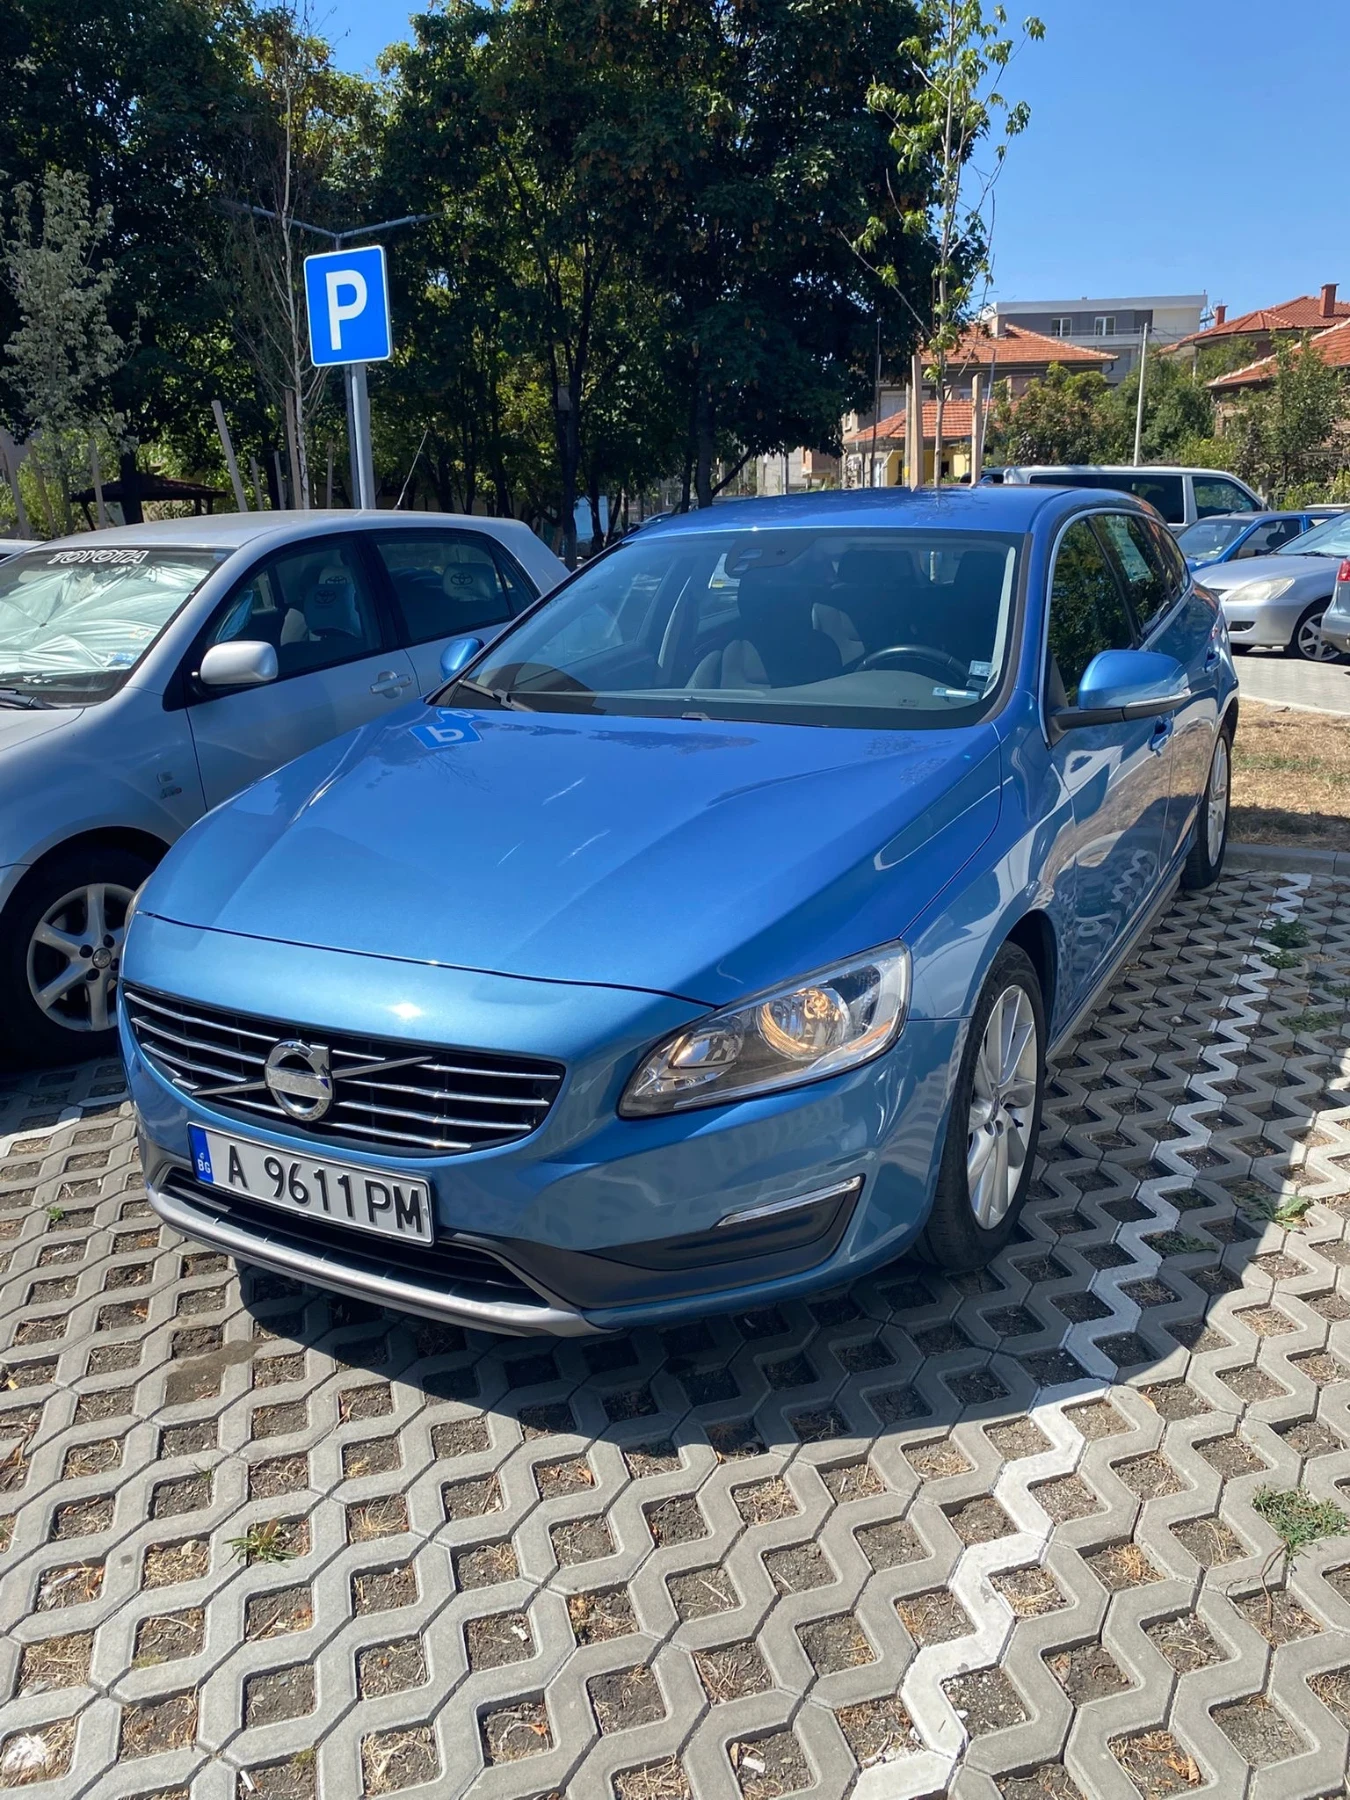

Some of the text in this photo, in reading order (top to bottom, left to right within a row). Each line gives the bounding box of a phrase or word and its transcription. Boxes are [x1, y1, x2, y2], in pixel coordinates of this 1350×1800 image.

[325, 269, 368, 351] P
[47, 549, 150, 565] TOYOTA
[198, 1159, 212, 1174] BG
[228, 1144, 248, 1188] A
